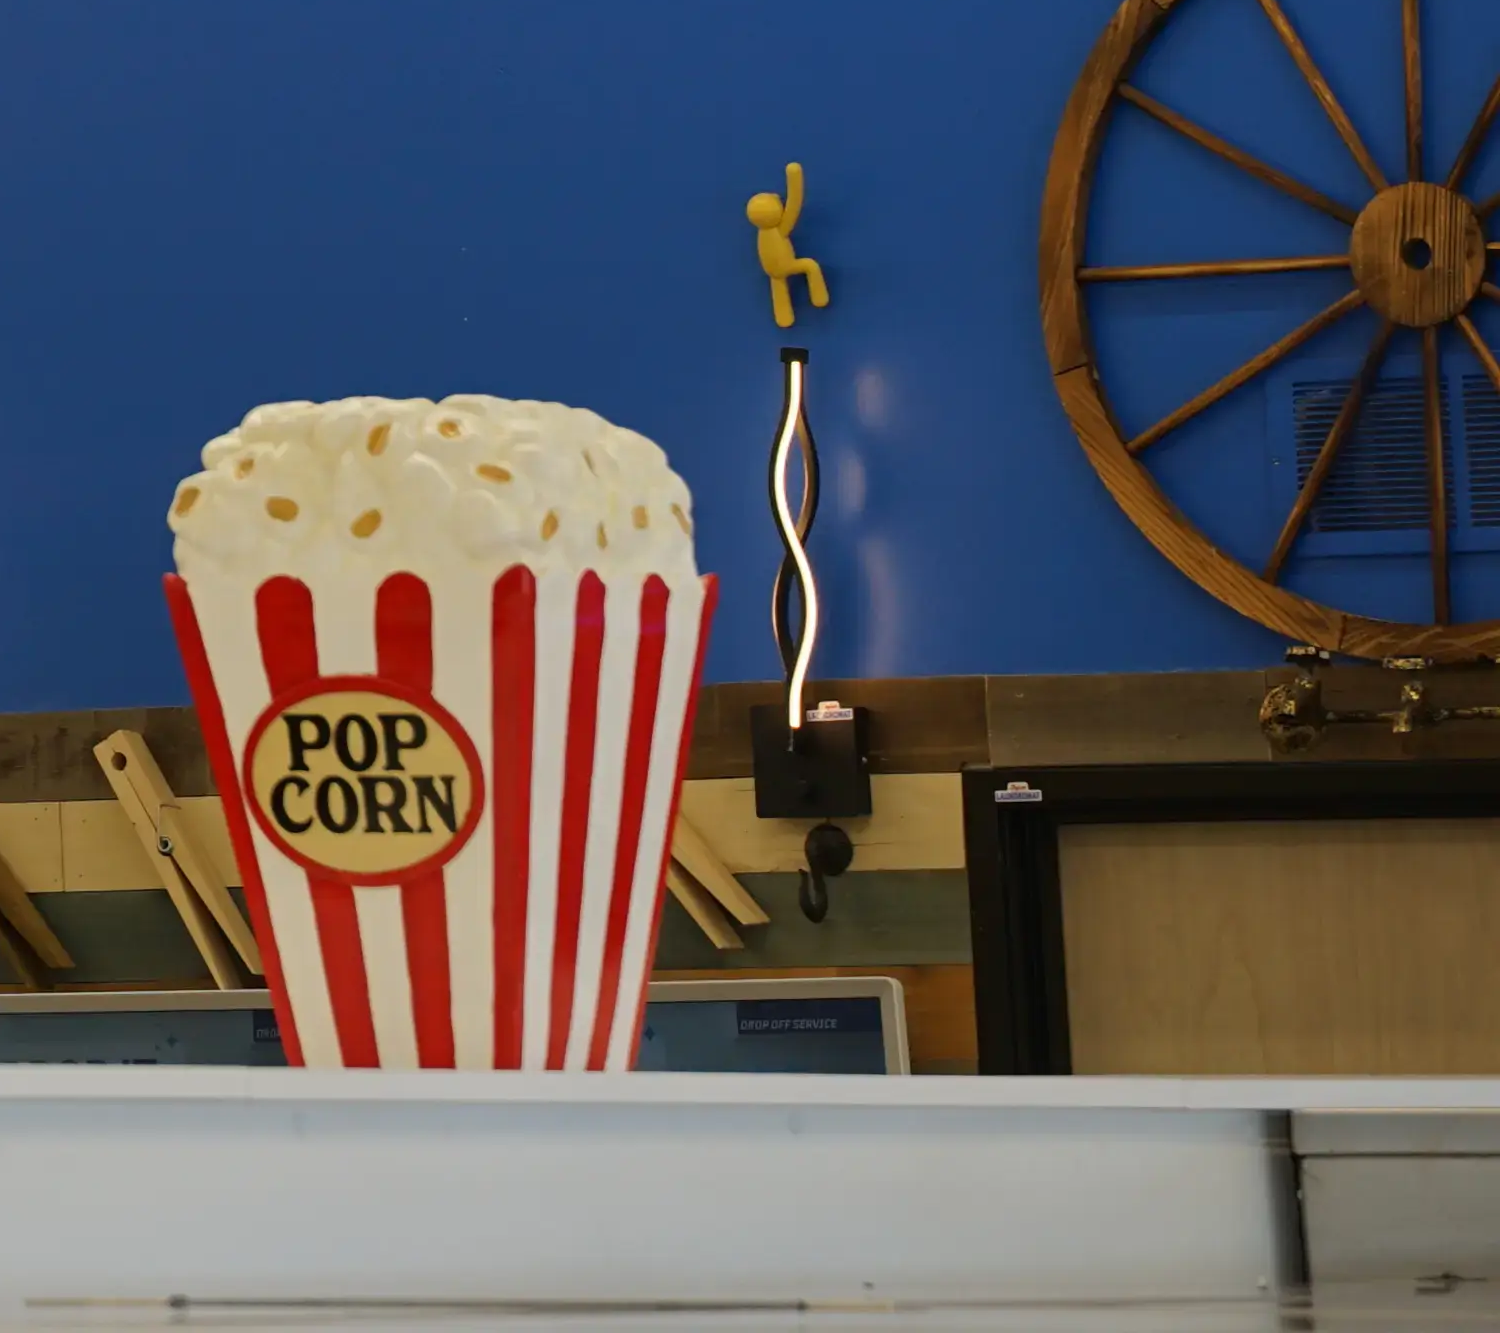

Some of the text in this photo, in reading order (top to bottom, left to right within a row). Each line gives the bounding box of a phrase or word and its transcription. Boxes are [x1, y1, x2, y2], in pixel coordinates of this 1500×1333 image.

[282, 713, 428, 772] POP
[270, 775, 457, 835] CORN
[771, 1018, 791, 1031] OFF
[792, 1018, 838, 1030] SERVICE
